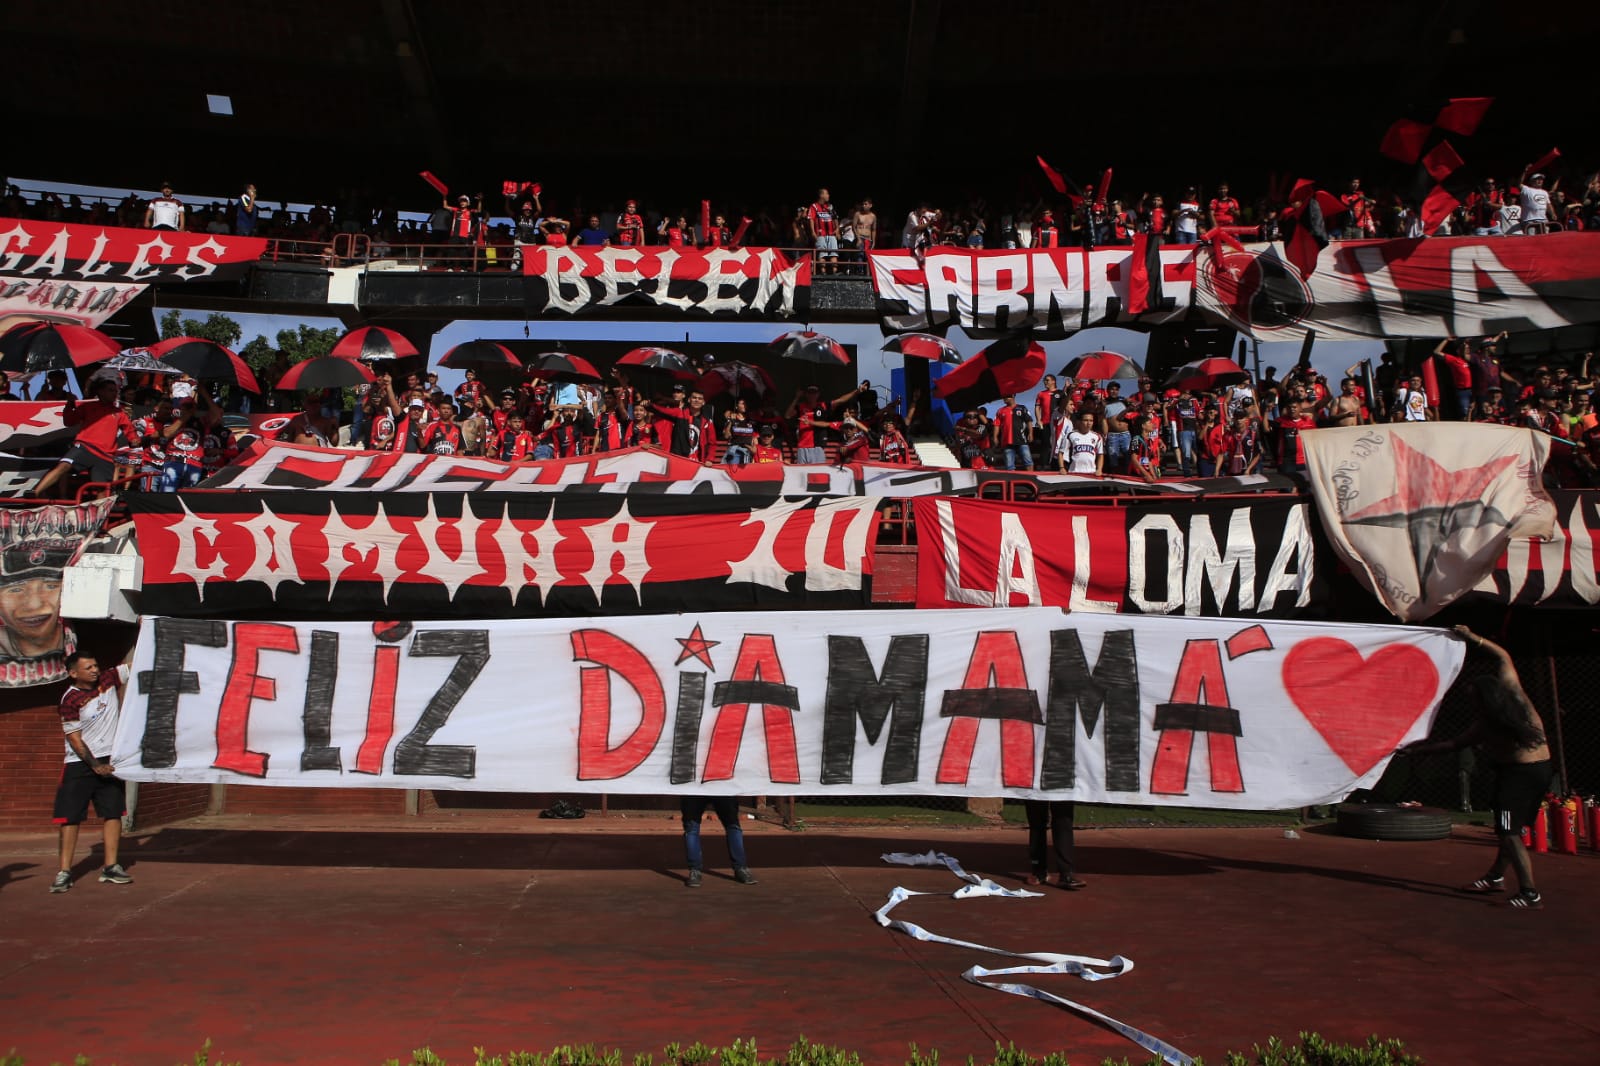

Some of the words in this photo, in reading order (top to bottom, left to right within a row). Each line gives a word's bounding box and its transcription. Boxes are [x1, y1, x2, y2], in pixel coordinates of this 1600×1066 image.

[935, 499, 1044, 608] LA
[1069, 503, 1315, 617] LOMA
[820, 624, 1274, 795] MAMÁ
